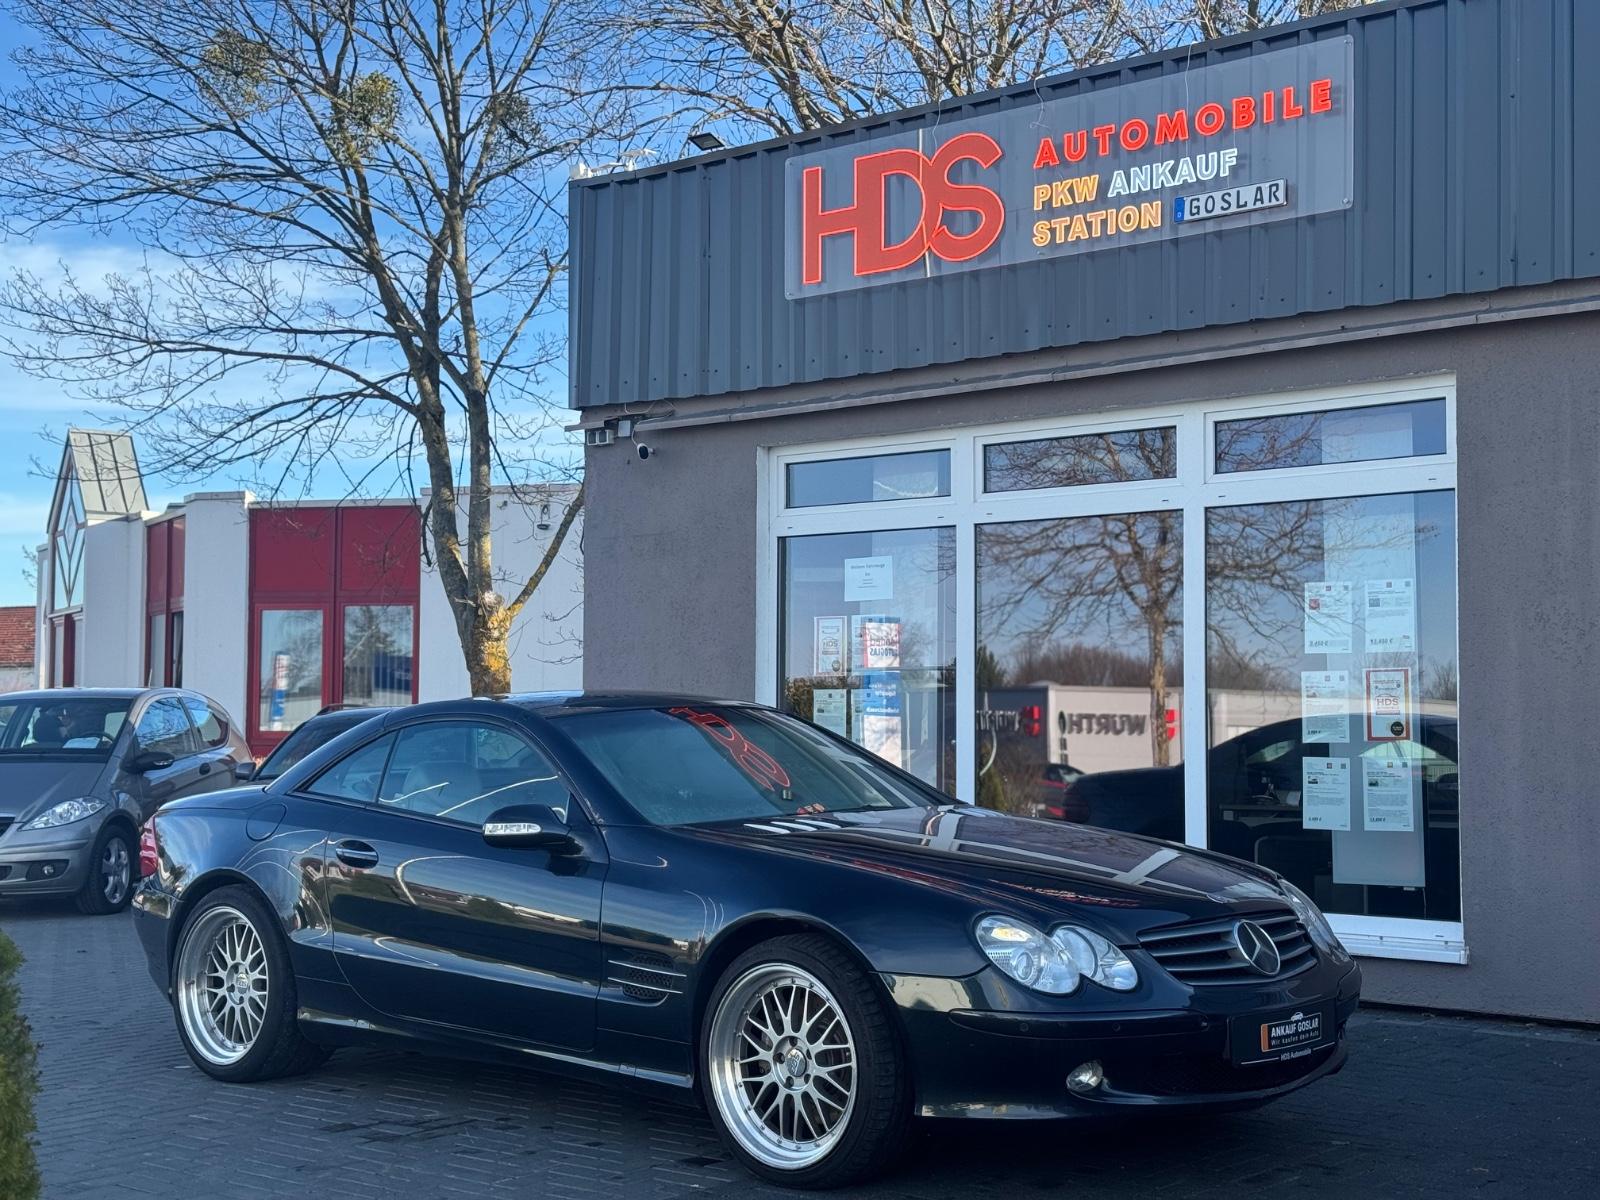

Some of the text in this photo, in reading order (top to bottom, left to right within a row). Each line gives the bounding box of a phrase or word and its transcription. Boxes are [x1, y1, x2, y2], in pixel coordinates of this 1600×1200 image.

[1033, 78, 1333, 169] AUTOMOBILE
[1033, 147, 1238, 211] PKW ANKAUF
[1188, 181, 1282, 218] GOSLAR
[803, 132, 1005, 284] HDS
[1032, 200, 1162, 247] STATION
[1376, 698, 1400, 706] HDS
[1271, 1018, 1318, 1038] ANKAUF GOSLAR
